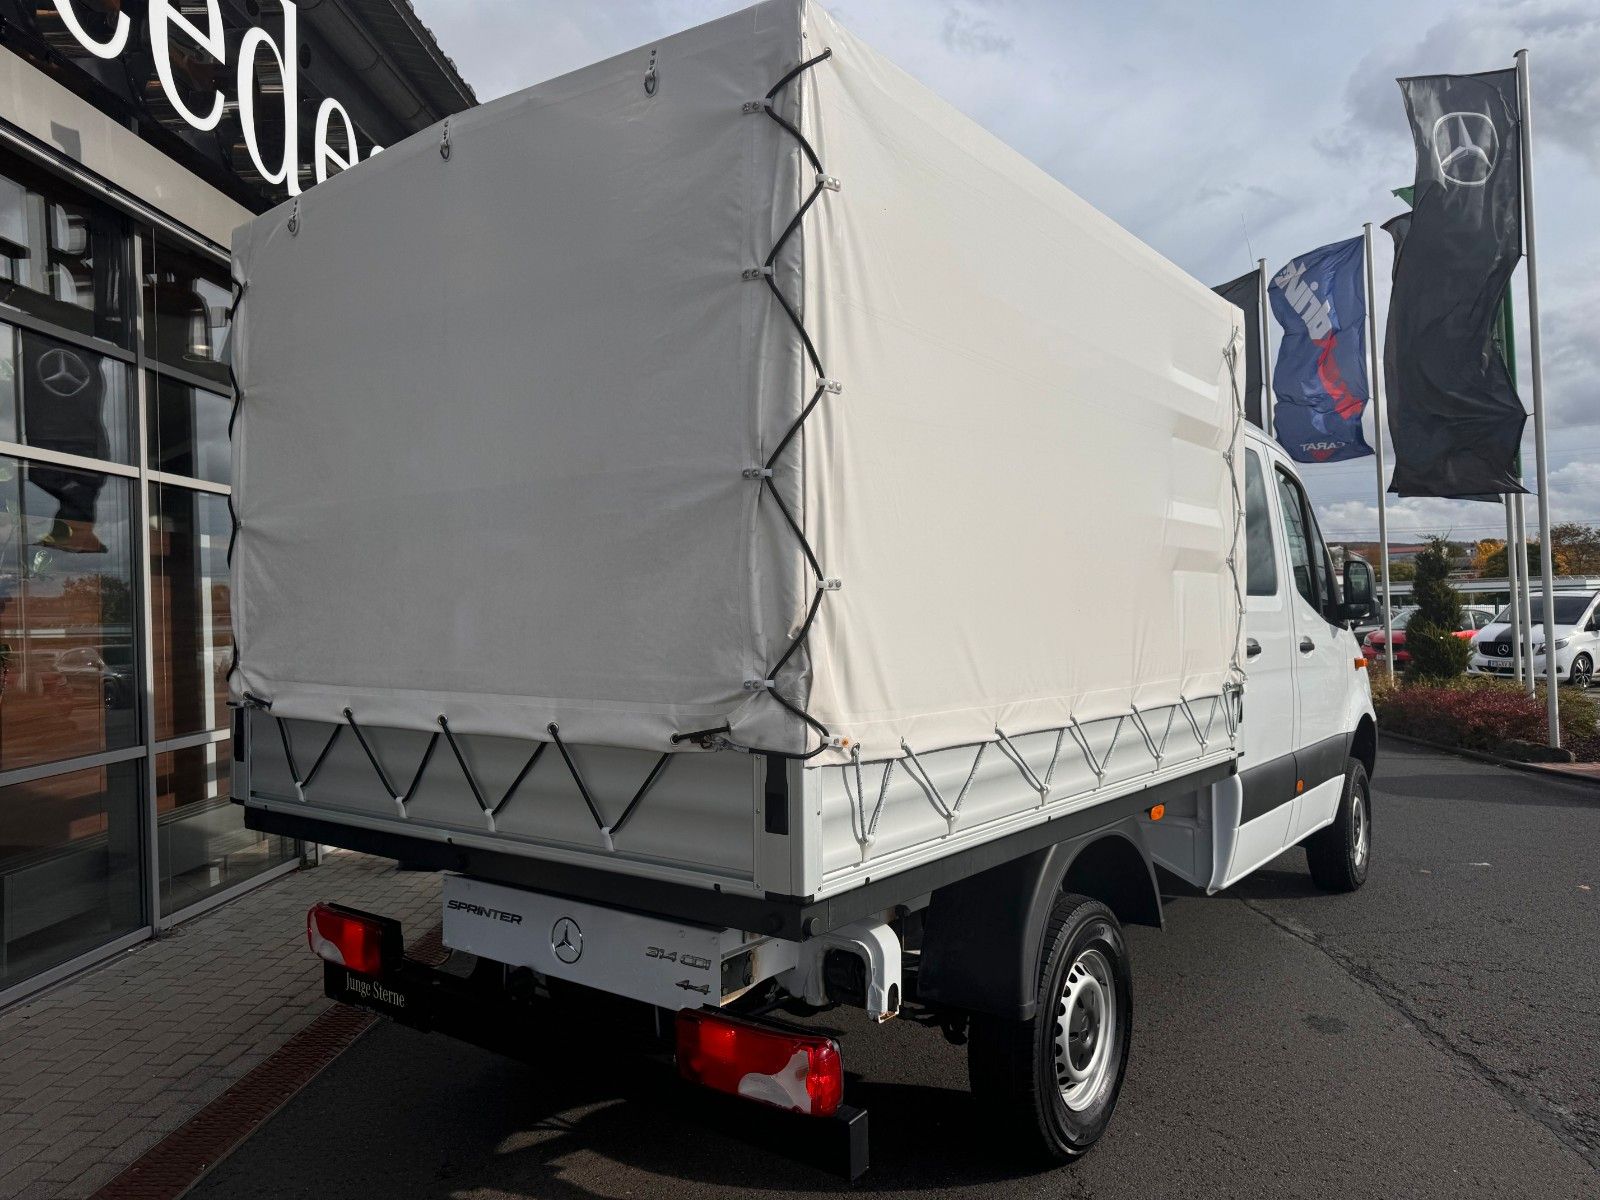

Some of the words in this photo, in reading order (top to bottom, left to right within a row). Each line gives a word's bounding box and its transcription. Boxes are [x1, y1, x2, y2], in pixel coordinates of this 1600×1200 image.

[447, 899, 523, 925] SPRINTER
[646, 945, 678, 963] 314
[680, 954, 712, 971] CDI
[345, 970, 371, 998] Junge
[373, 981, 405, 1009] Sterne
